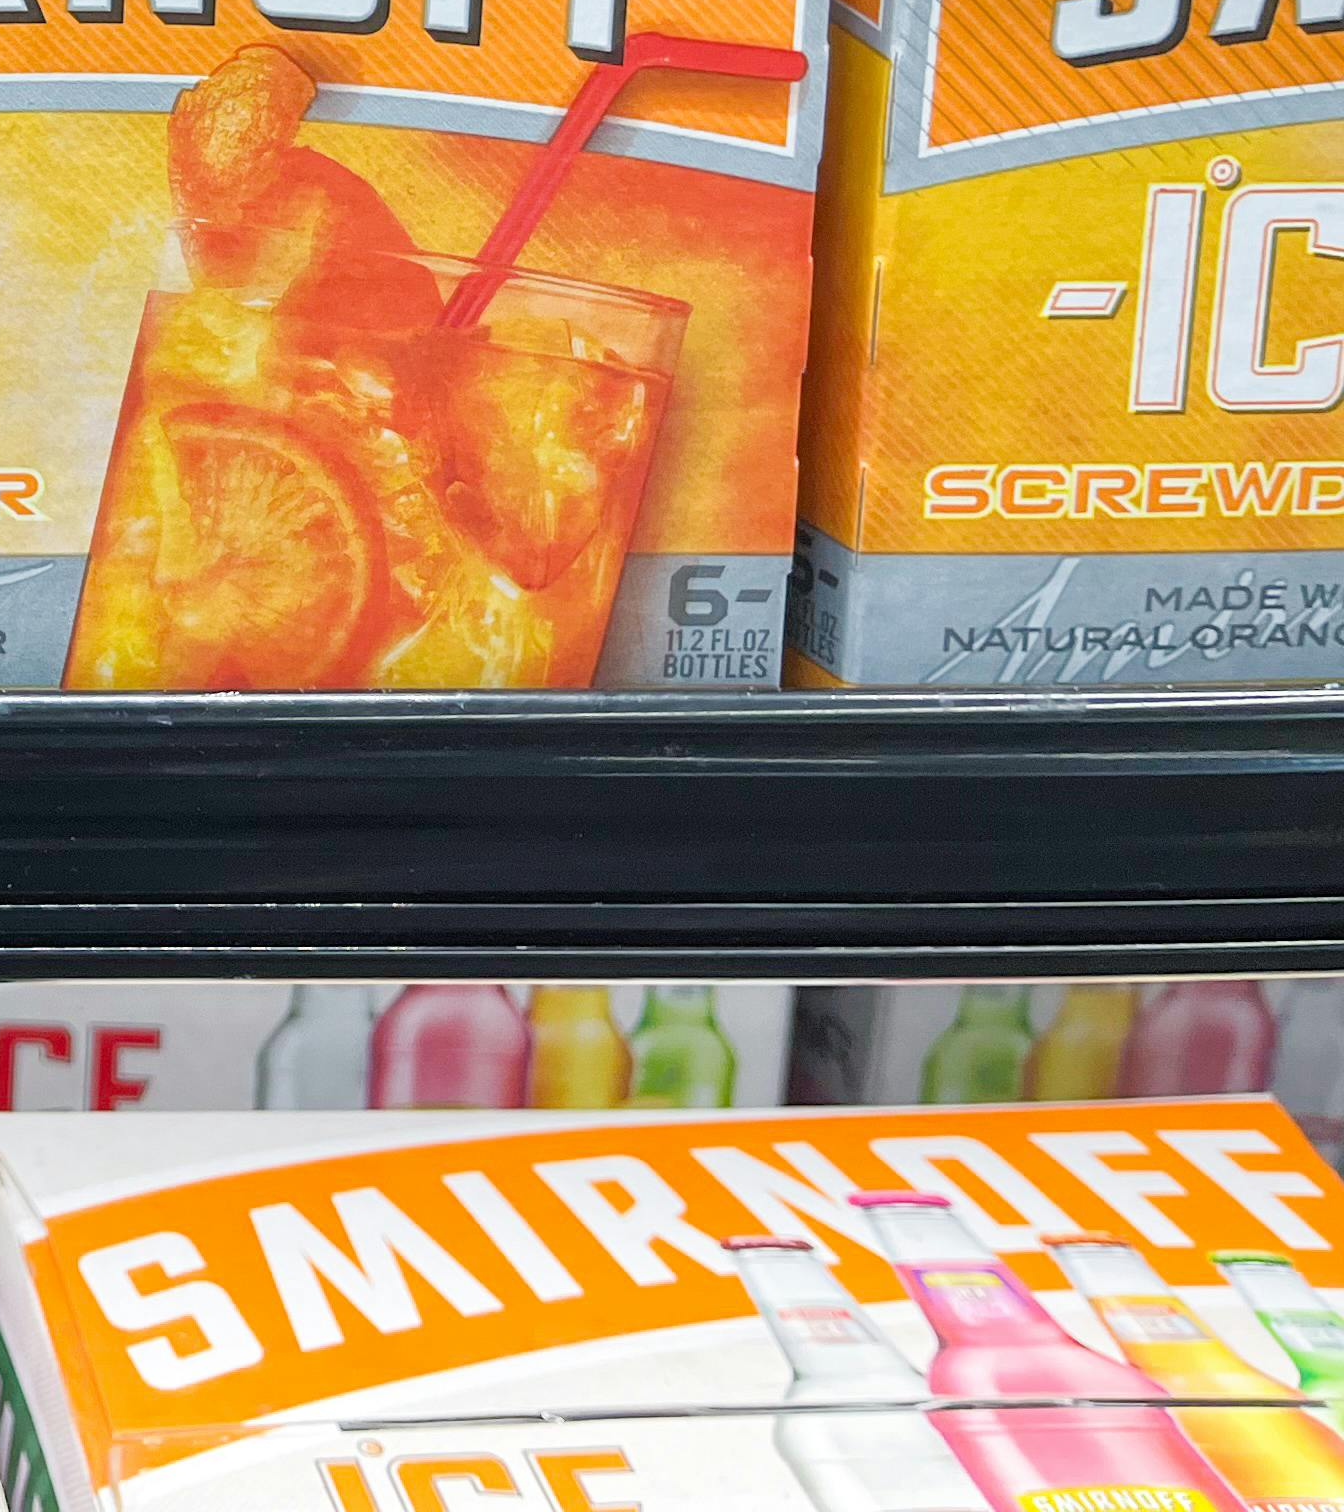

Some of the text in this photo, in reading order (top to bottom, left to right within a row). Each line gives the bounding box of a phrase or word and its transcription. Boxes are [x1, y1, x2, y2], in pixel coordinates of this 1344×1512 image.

[1144, 584, 1287, 612] MADE
[665, 628, 704, 653] 11.2
[943, 624, 1179, 653] NATURAL
[663, 653, 768, 679] BOTTLES
[77, 1127, 1336, 1392] SMIRNOFF
